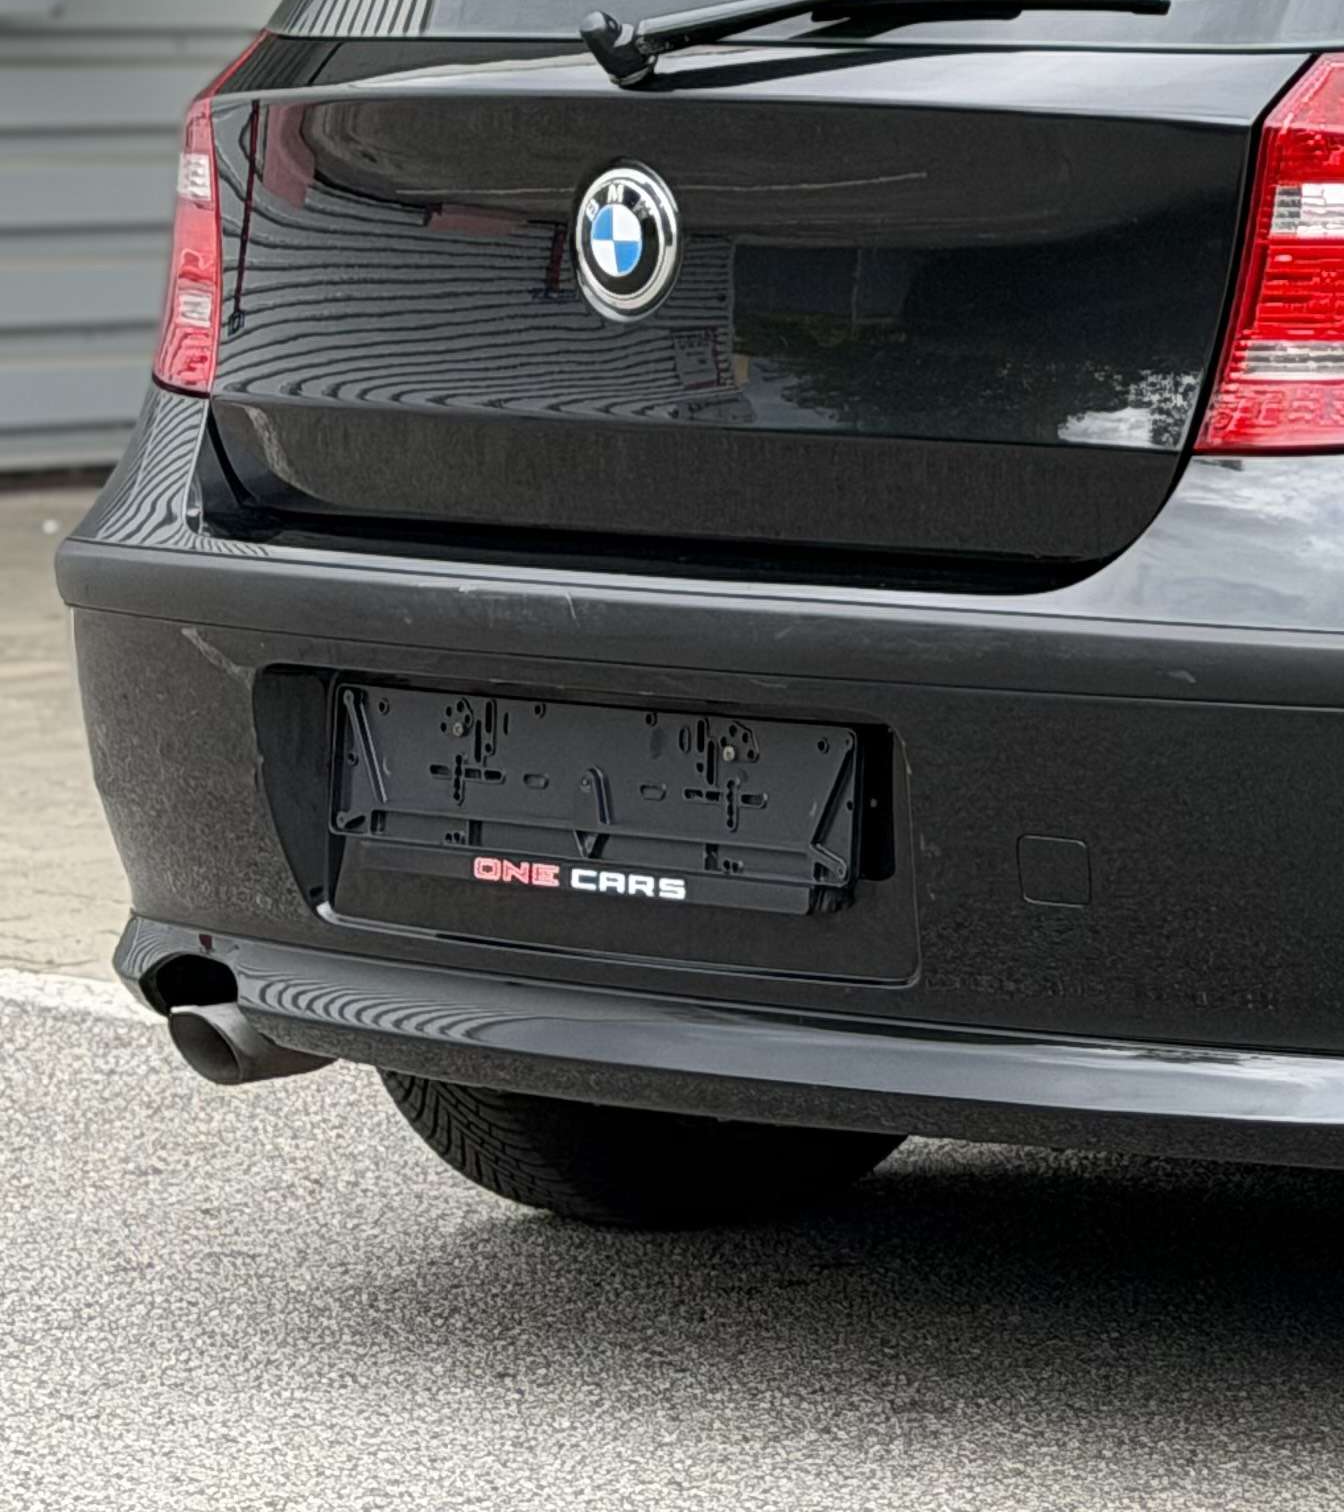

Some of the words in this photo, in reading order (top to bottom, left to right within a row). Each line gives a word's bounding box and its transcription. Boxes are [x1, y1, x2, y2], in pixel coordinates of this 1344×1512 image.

[585, 181, 652, 222] BMW
[473, 856, 560, 887] ONE
[571, 868, 686, 900] CARS
